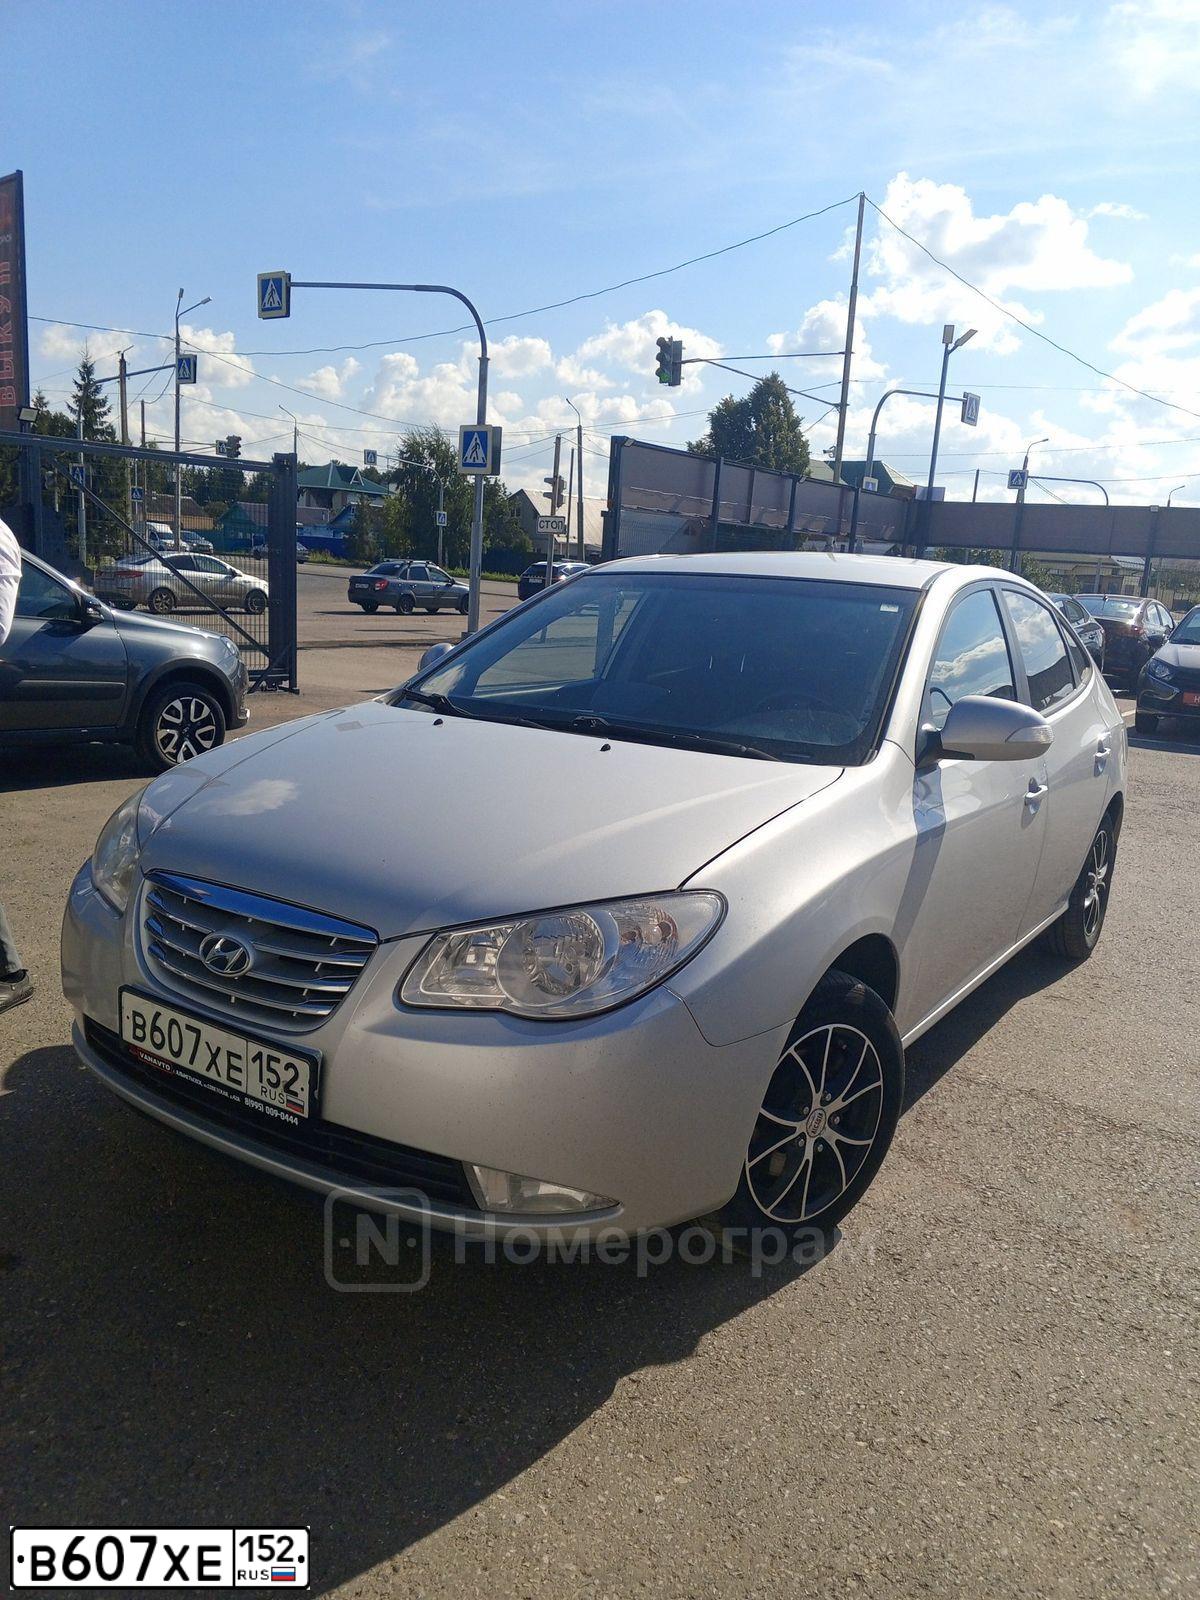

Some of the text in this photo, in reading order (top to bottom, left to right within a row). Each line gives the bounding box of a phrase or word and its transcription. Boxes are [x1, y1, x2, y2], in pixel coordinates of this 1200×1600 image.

[538, 519, 563, 530] СТОП
[251, 1051, 299, 1097] 152
[260, 1086, 285, 1105] RUS
